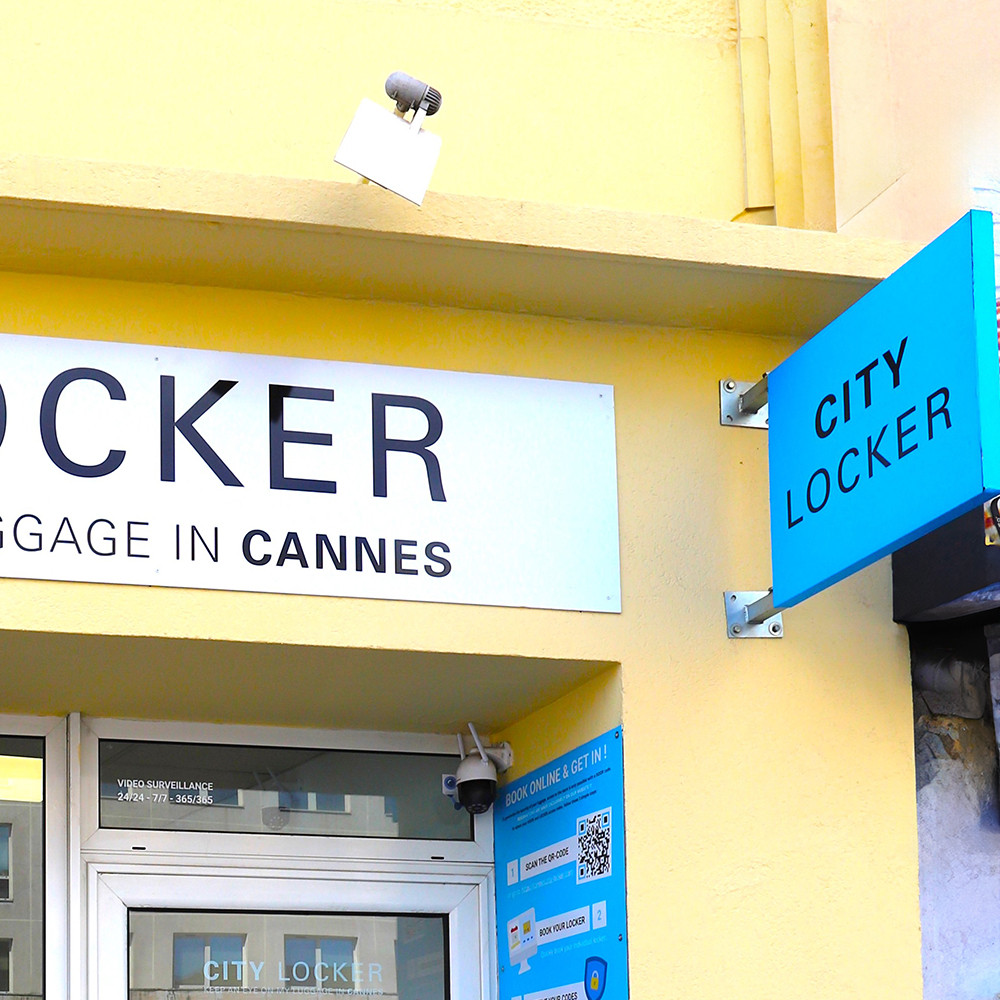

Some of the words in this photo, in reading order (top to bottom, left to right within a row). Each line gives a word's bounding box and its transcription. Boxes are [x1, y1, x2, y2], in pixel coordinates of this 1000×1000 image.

[814, 336, 909, 439] CITY
[786, 386, 952, 530] LOCKER
[174, 524, 219, 563] IN
[241, 529, 452, 578] CANNES
[117, 779, 145, 788] VIDEO
[146, 780, 214, 791] SURVEILLANCE
[505, 784, 529, 808] BOOK
[530, 768, 561, 795] ONLINE
[562, 764, 569, 779] &
[570, 752, 589, 775] GET
[591, 748, 602, 765] IN
[117, 793, 145, 802] 24/24
[152, 793, 168, 803] 7/7
[175, 794, 214, 805] 365/365
[525, 860, 538, 871] SCAN
[538, 856, 547, 867] THE
[547, 847, 569, 863] QR-CODE
[539, 926, 552, 937] BOOK
[552, 921, 565, 933] YOUR
[565, 916, 586, 929] LOCKER
[203, 961, 264, 981] CITY
[278, 961, 383, 982] LOCKER
